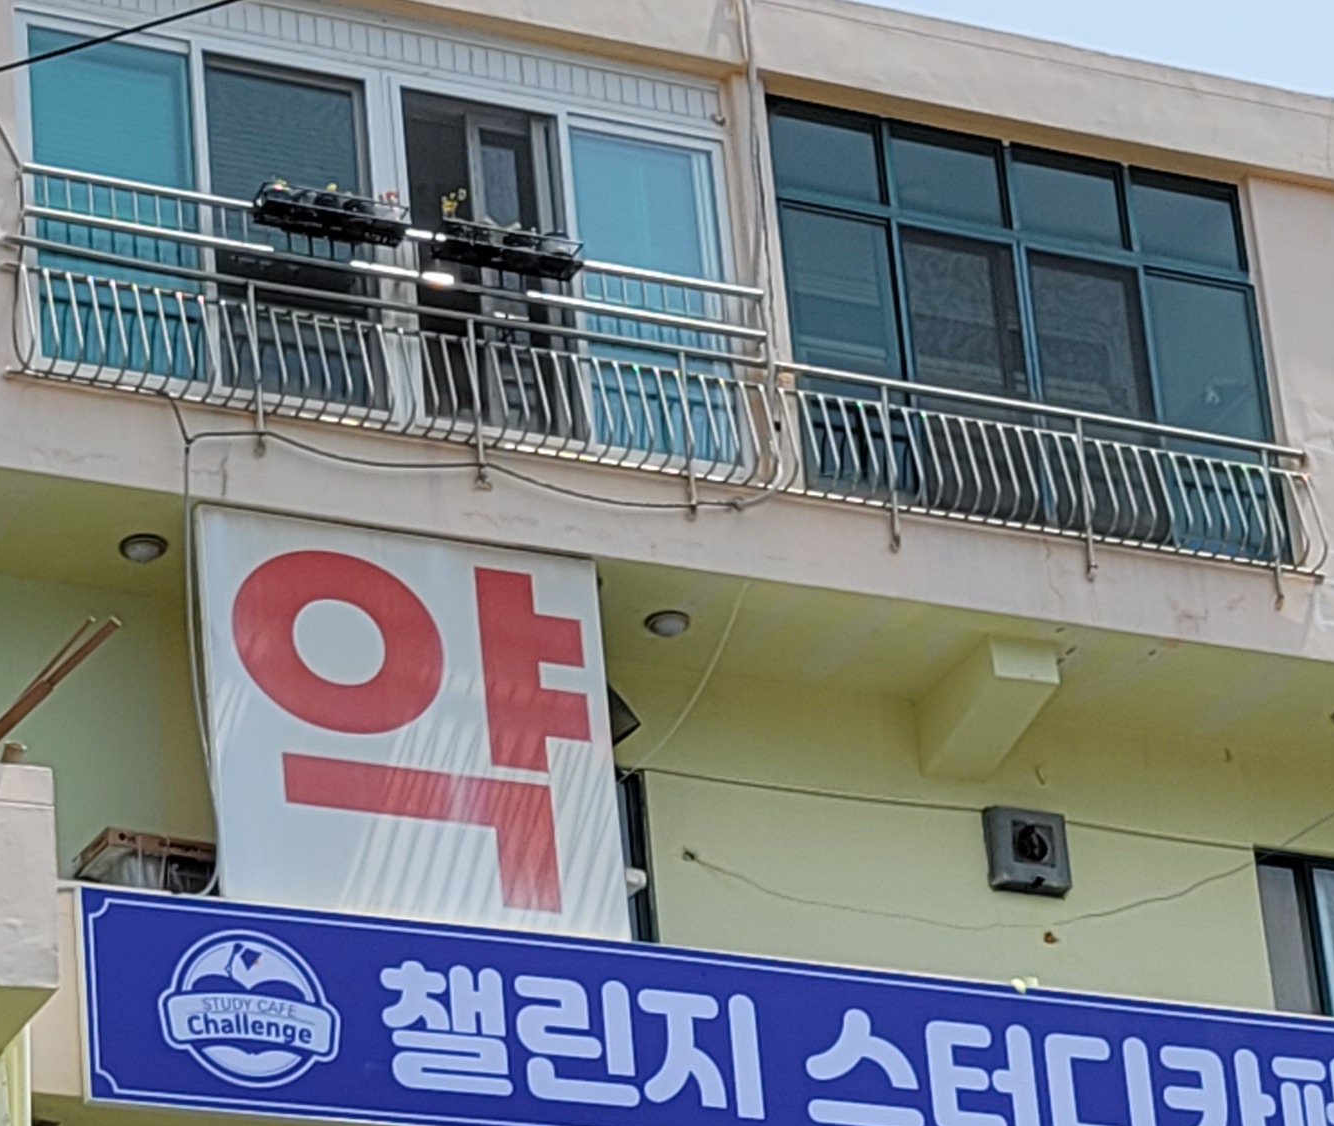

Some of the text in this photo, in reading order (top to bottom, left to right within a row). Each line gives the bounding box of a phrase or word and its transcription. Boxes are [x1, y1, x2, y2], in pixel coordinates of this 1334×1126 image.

[231, 549, 592, 914] 약
[186, 1012, 313, 1046] Challenge
[202, 996, 297, 1018] STUDY CAFE
[379, 960, 766, 1121] 챌린지
